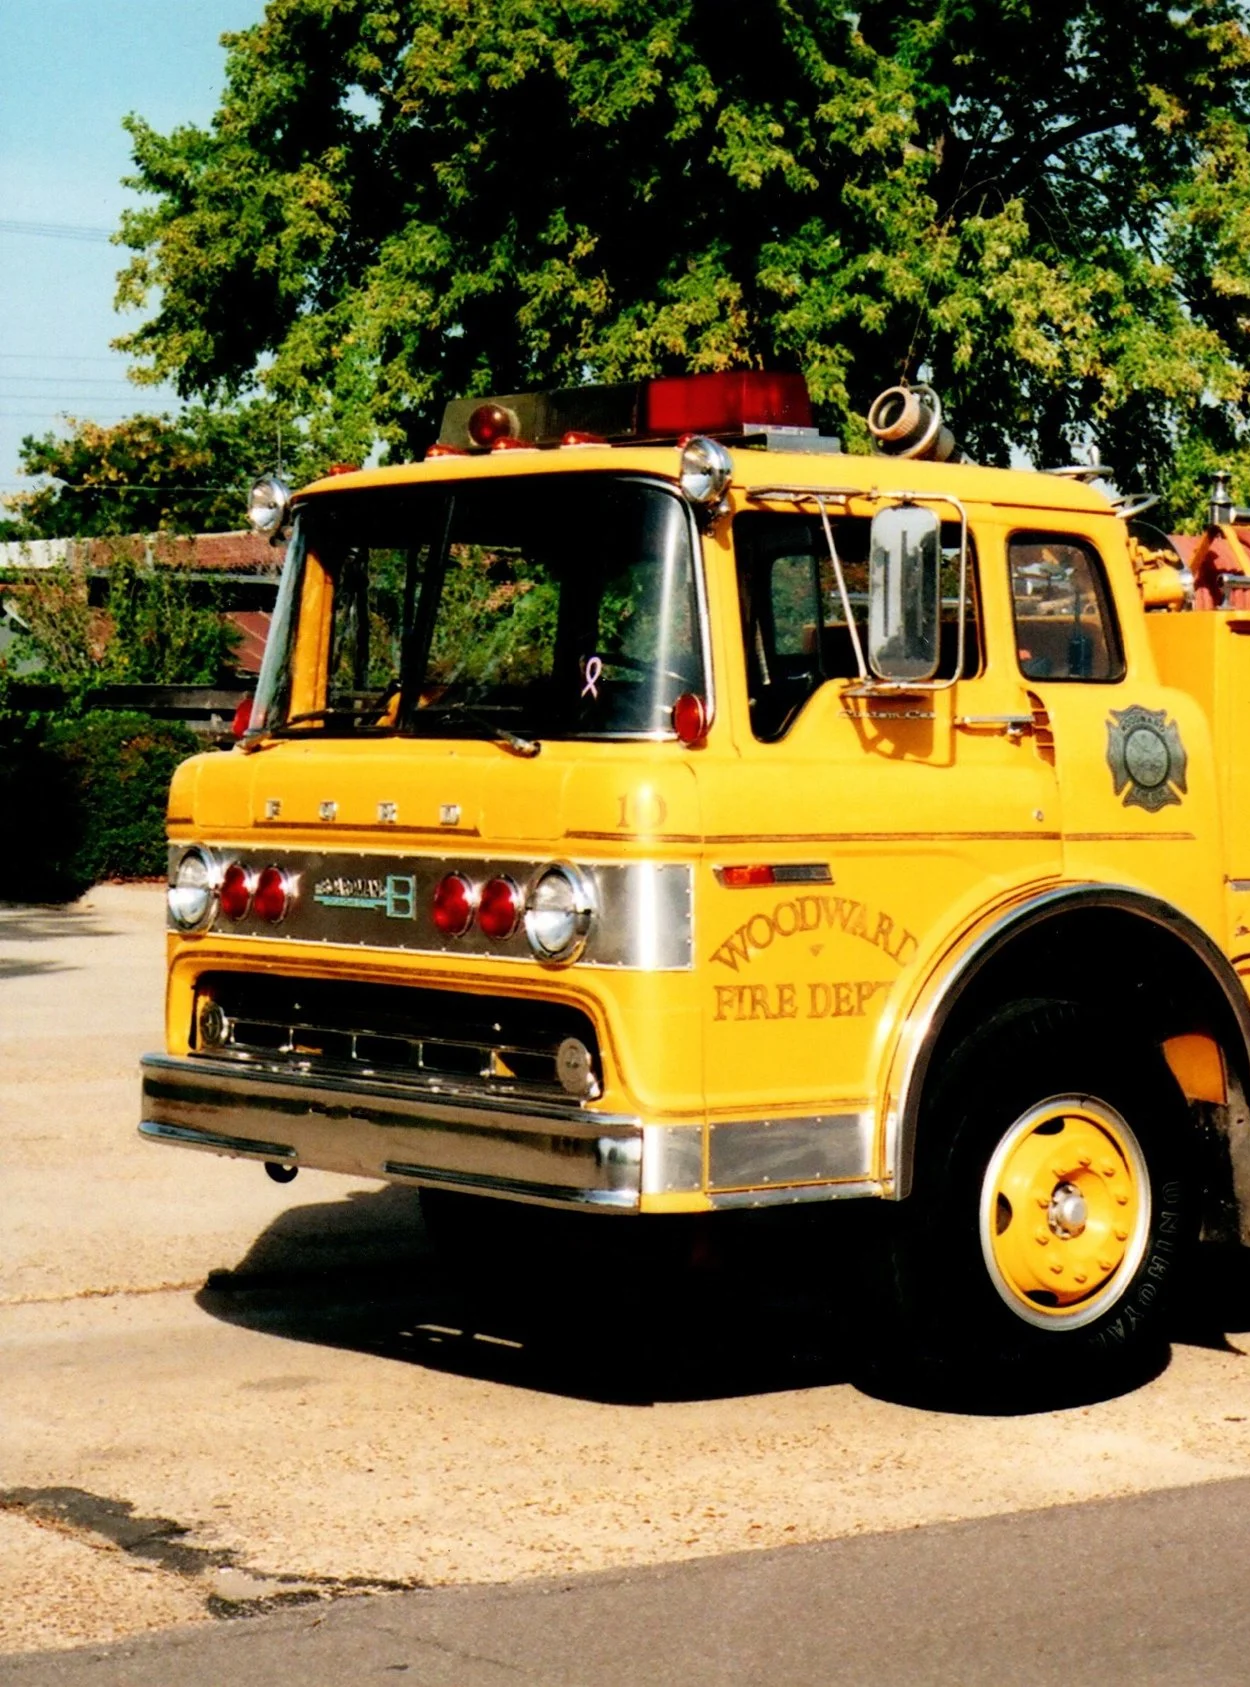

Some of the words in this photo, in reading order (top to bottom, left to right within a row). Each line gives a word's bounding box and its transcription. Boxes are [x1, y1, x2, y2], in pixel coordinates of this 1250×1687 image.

[616, 792, 668, 829] 10
[708, 895, 919, 973] WOODWARD
[713, 983, 798, 1021] FIRE
